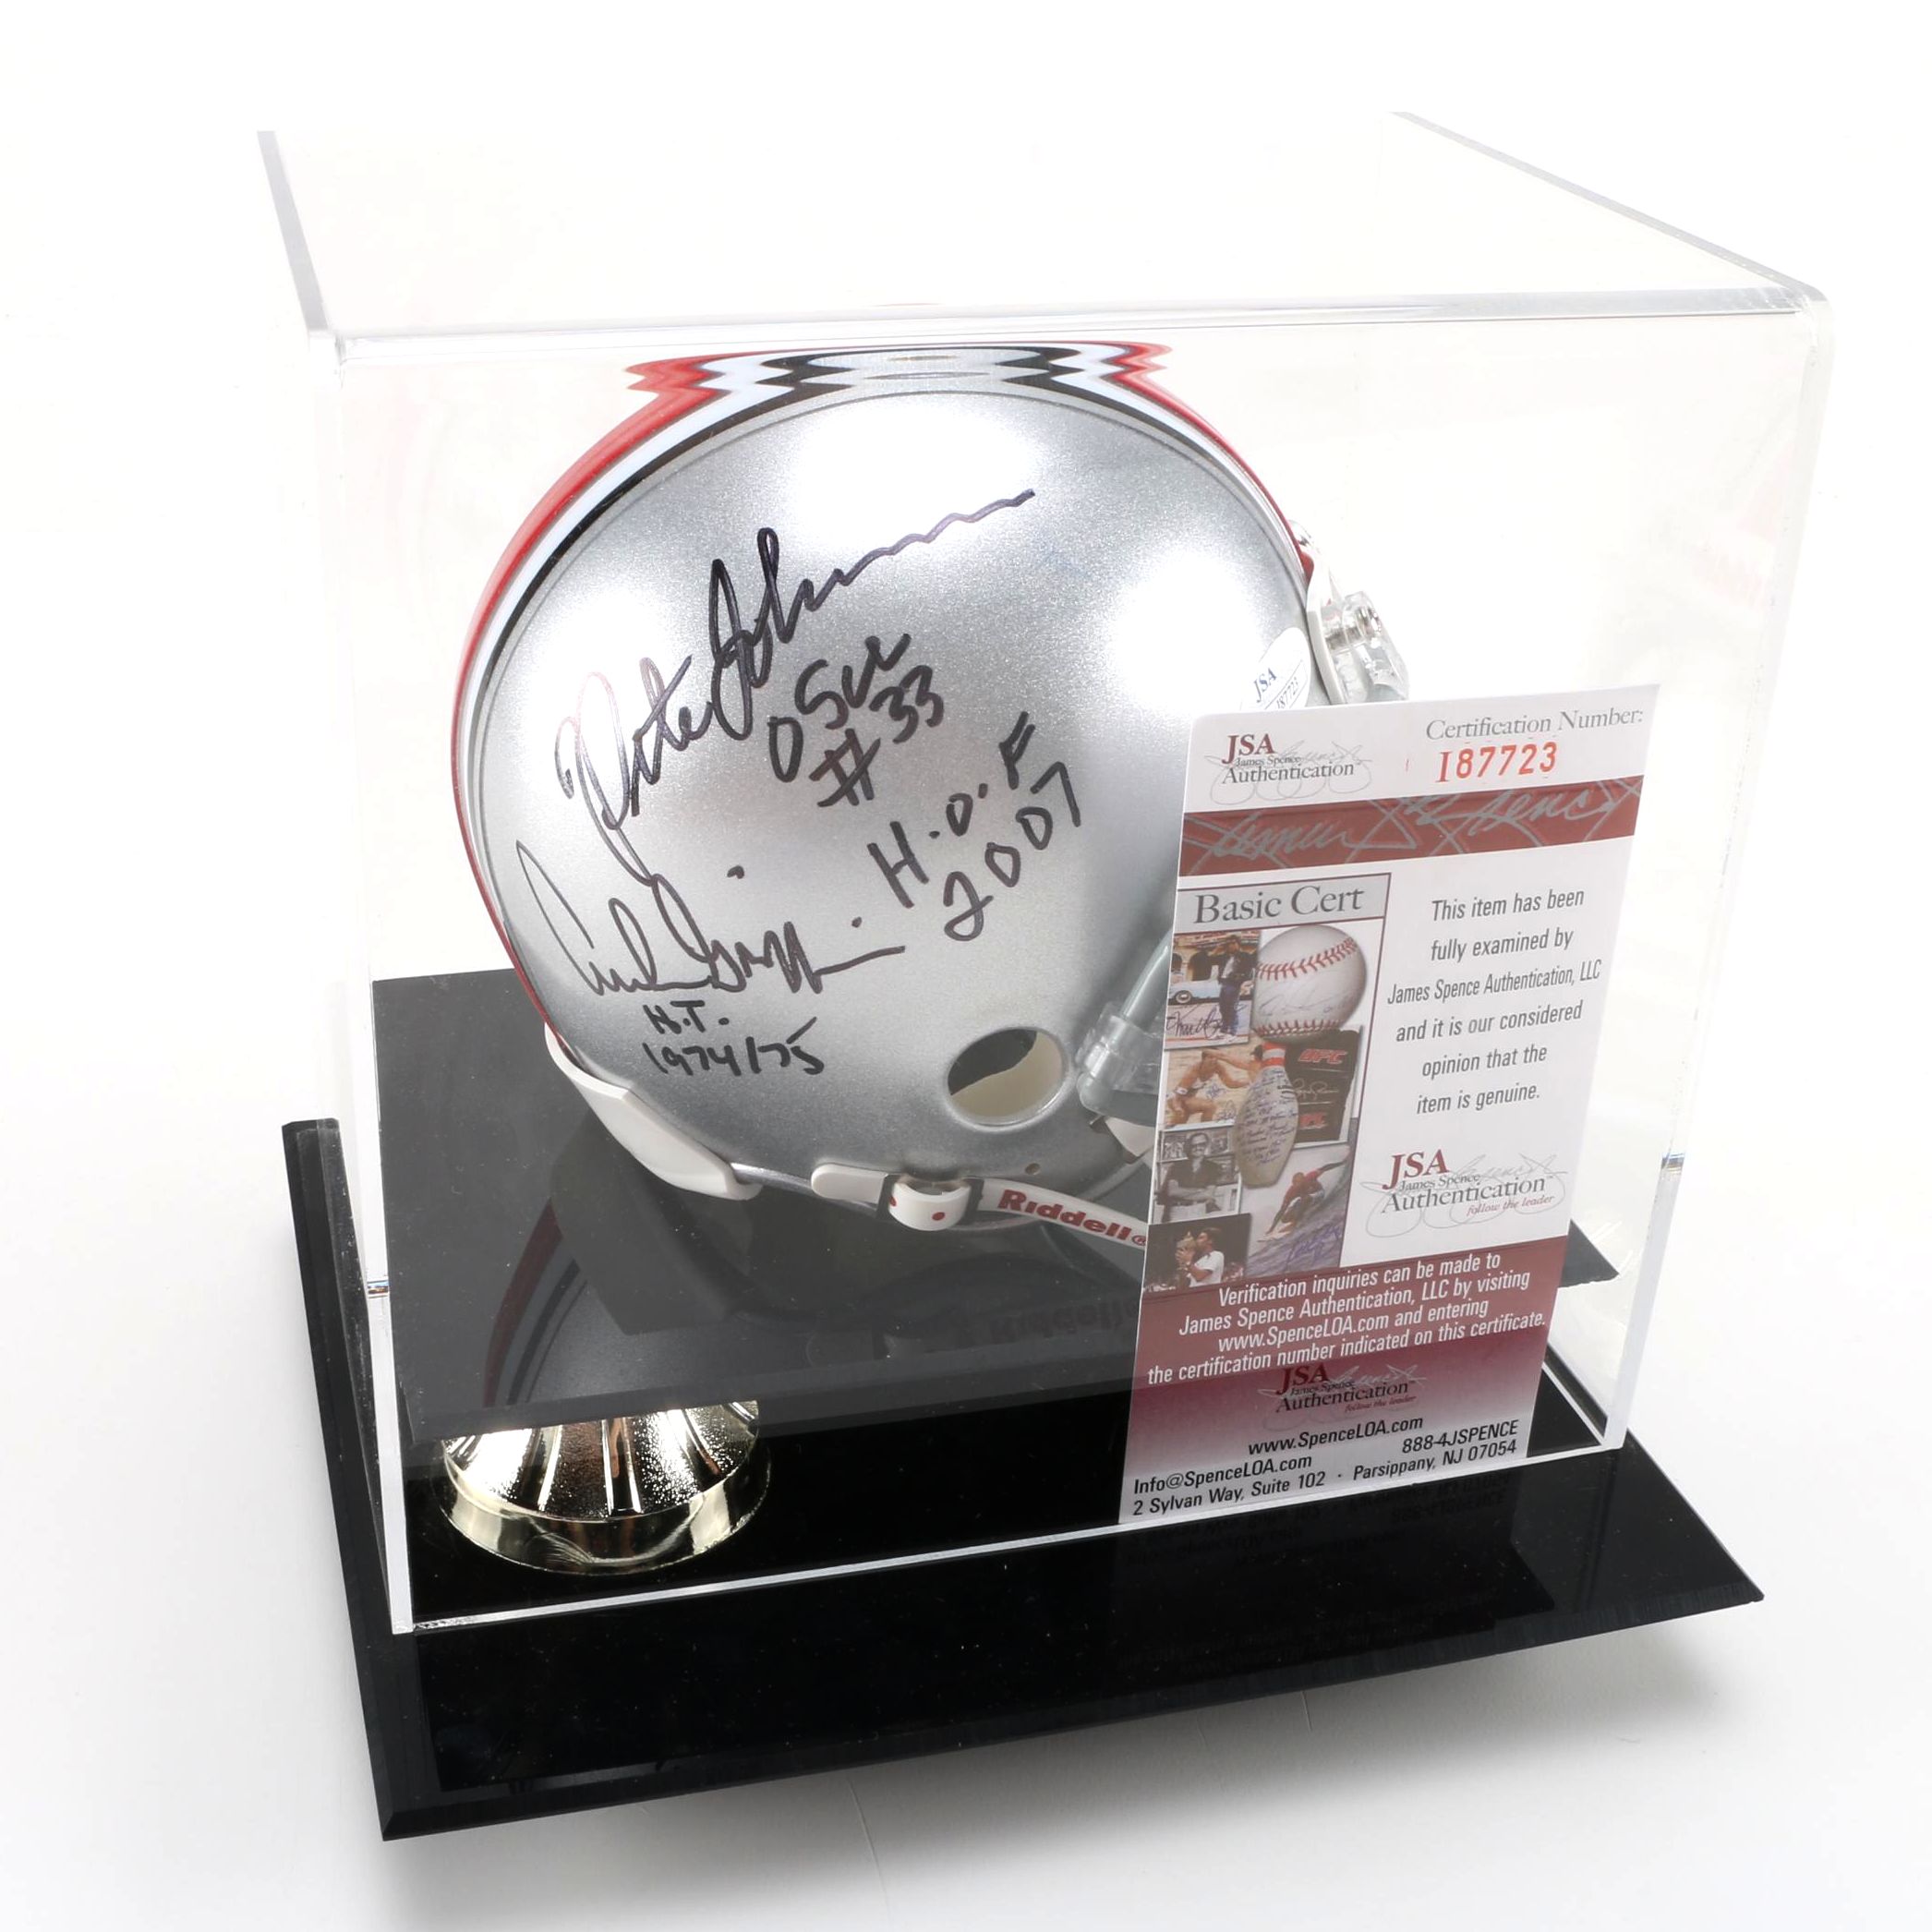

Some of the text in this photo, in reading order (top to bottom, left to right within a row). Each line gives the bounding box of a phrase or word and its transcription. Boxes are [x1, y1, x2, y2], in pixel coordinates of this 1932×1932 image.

[1254, 668, 1276, 703] JSA
[809, 665, 944, 807] #33
[1426, 707, 1643, 740] Certification Number:
[1222, 733, 1275, 765] JSA
[1235, 754, 1301, 767] James Spence
[1435, 742, 1557, 783] I87723
[1222, 761, 1354, 784] Authentication
[944, 762, 1081, 941] 2007
[1193, 885, 1364, 924] Basic Cert
[1431, 888, 1585, 921] This item has been
[1431, 926, 1574, 962] fully examined by
[1387, 959, 1601, 1005] James Spence Authentication, LLC
[1395, 999, 1584, 1042] and it is our considered
[1422, 1044, 1547, 1080] opinion that the
[1417, 1082, 1540, 1115] item is genuine.
[1382, 1149, 1450, 1190] JSA
[1399, 1174, 1480, 1191] James Spence
[1466, 1194, 1555, 1217] follow the leader
[1219, 1252, 1501, 1307] Verification inquiries can be made to
[1179, 1270, 1530, 1335] James Spence Authentication, LLC by visiting
[1218, 1298, 1490, 1352] www.SpenceLOA.com and entering
[1147, 1311, 1546, 1384] the certification number indicated on this certificate.
[1275, 1362, 1330, 1395] JSA
[1248, 1418, 1423, 1455] www.SpenceLOA.com
[1402, 1419, 1519, 1454] 888-4JSPENCE
[1133, 1439, 1517, 1515] 2 Sylvan Way, Suite 102 Parsippany, NJ 07054
[1134, 1456, 1312, 1494] Info@SpenceLOA.com
